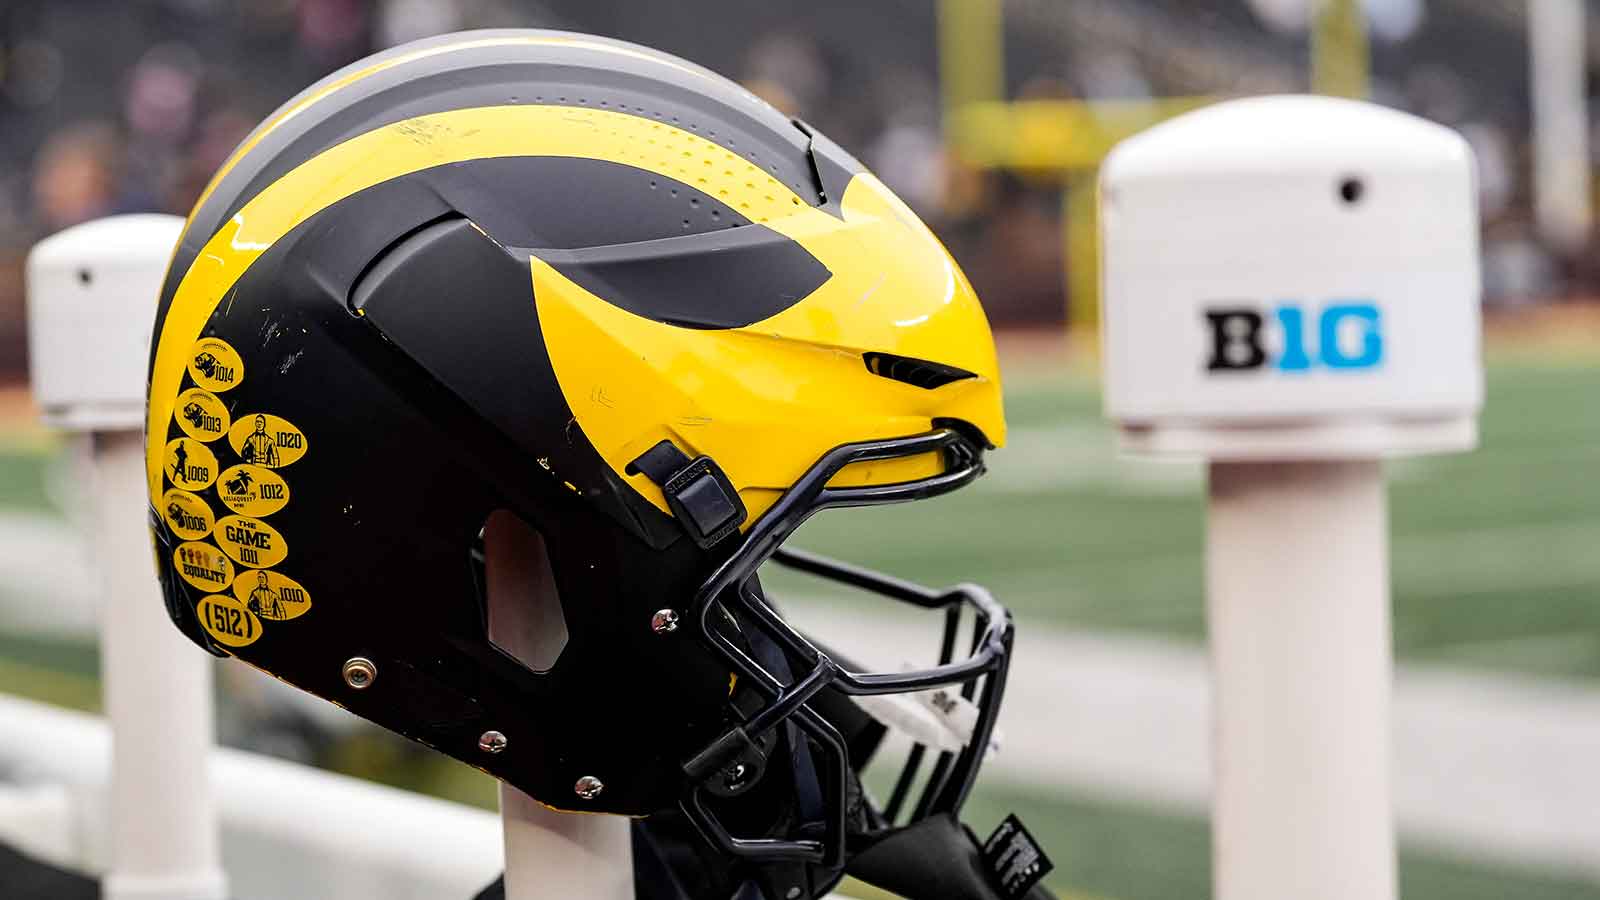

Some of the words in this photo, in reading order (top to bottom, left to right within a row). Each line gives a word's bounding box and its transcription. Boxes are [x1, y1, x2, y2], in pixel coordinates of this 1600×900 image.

[215, 366, 234, 383] 1014
[203, 415, 221, 433] 1013
[276, 431, 302, 449] 1020
[187, 464, 209, 483] 1009
[259, 484, 284, 500] 1012
[185, 515, 207, 532] 1006
[237, 519, 257, 529] THE
[225, 525, 271, 550] GAME
[239, 547, 260, 565] 1011
[183, 562, 226, 584] EQUALITY
[279, 587, 305, 603] 1010
[204, 602, 253, 639] (512)
